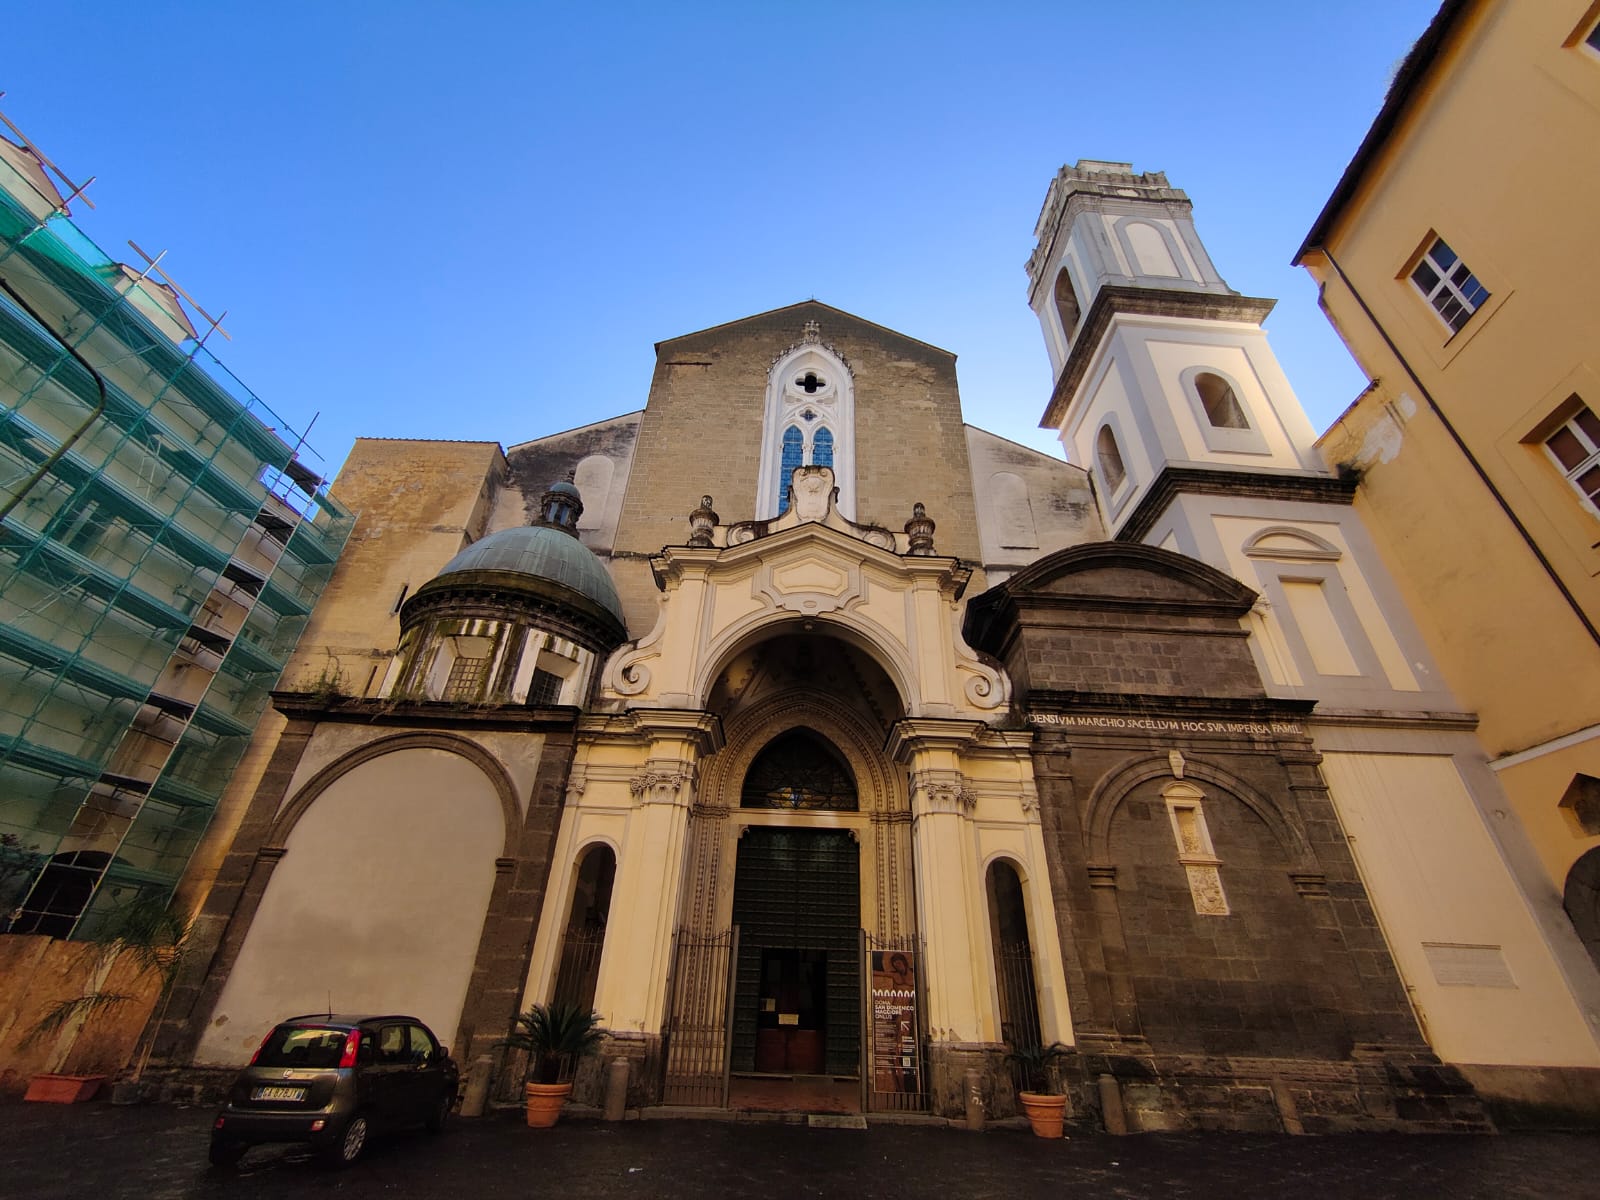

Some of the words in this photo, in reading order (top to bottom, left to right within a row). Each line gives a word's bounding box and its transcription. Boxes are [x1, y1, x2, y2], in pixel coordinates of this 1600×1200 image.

[1077, 717, 1125, 728] MARCHIO
[1127, 719, 1179, 730] SACELLVM
[1181, 722, 1206, 732] HOC
[1207, 722, 1226, 732] SVA
[1227, 723, 1272, 734] IMPENSA
[1272, 724, 1303, 734] FAMIL
